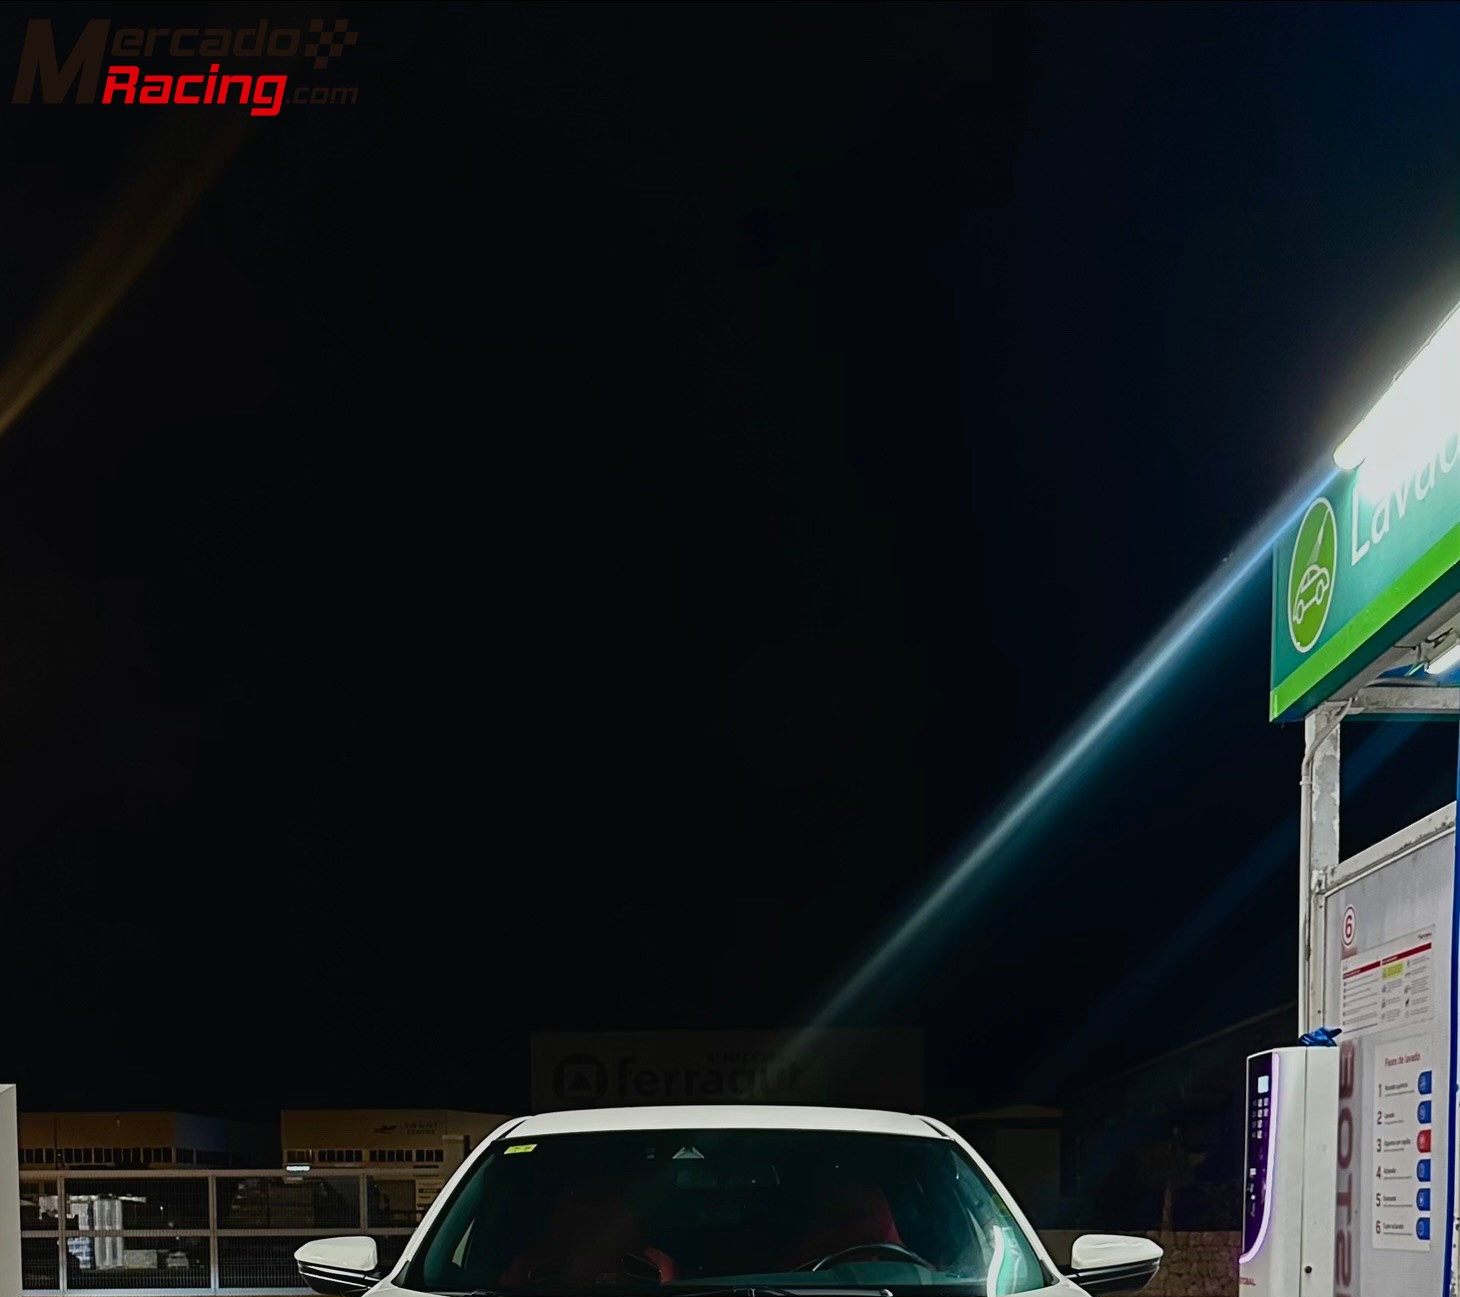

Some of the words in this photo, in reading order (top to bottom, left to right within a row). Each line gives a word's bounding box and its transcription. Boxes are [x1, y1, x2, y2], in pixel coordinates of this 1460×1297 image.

[1345, 915, 1352, 938] 6
[1377, 1110, 1382, 1125] 2
[1376, 1138, 1382, 1152] 3
[1376, 1165, 1381, 1179] 4
[1375, 1193, 1381, 1207] 5
[1375, 1220, 1381, 1235] 6
